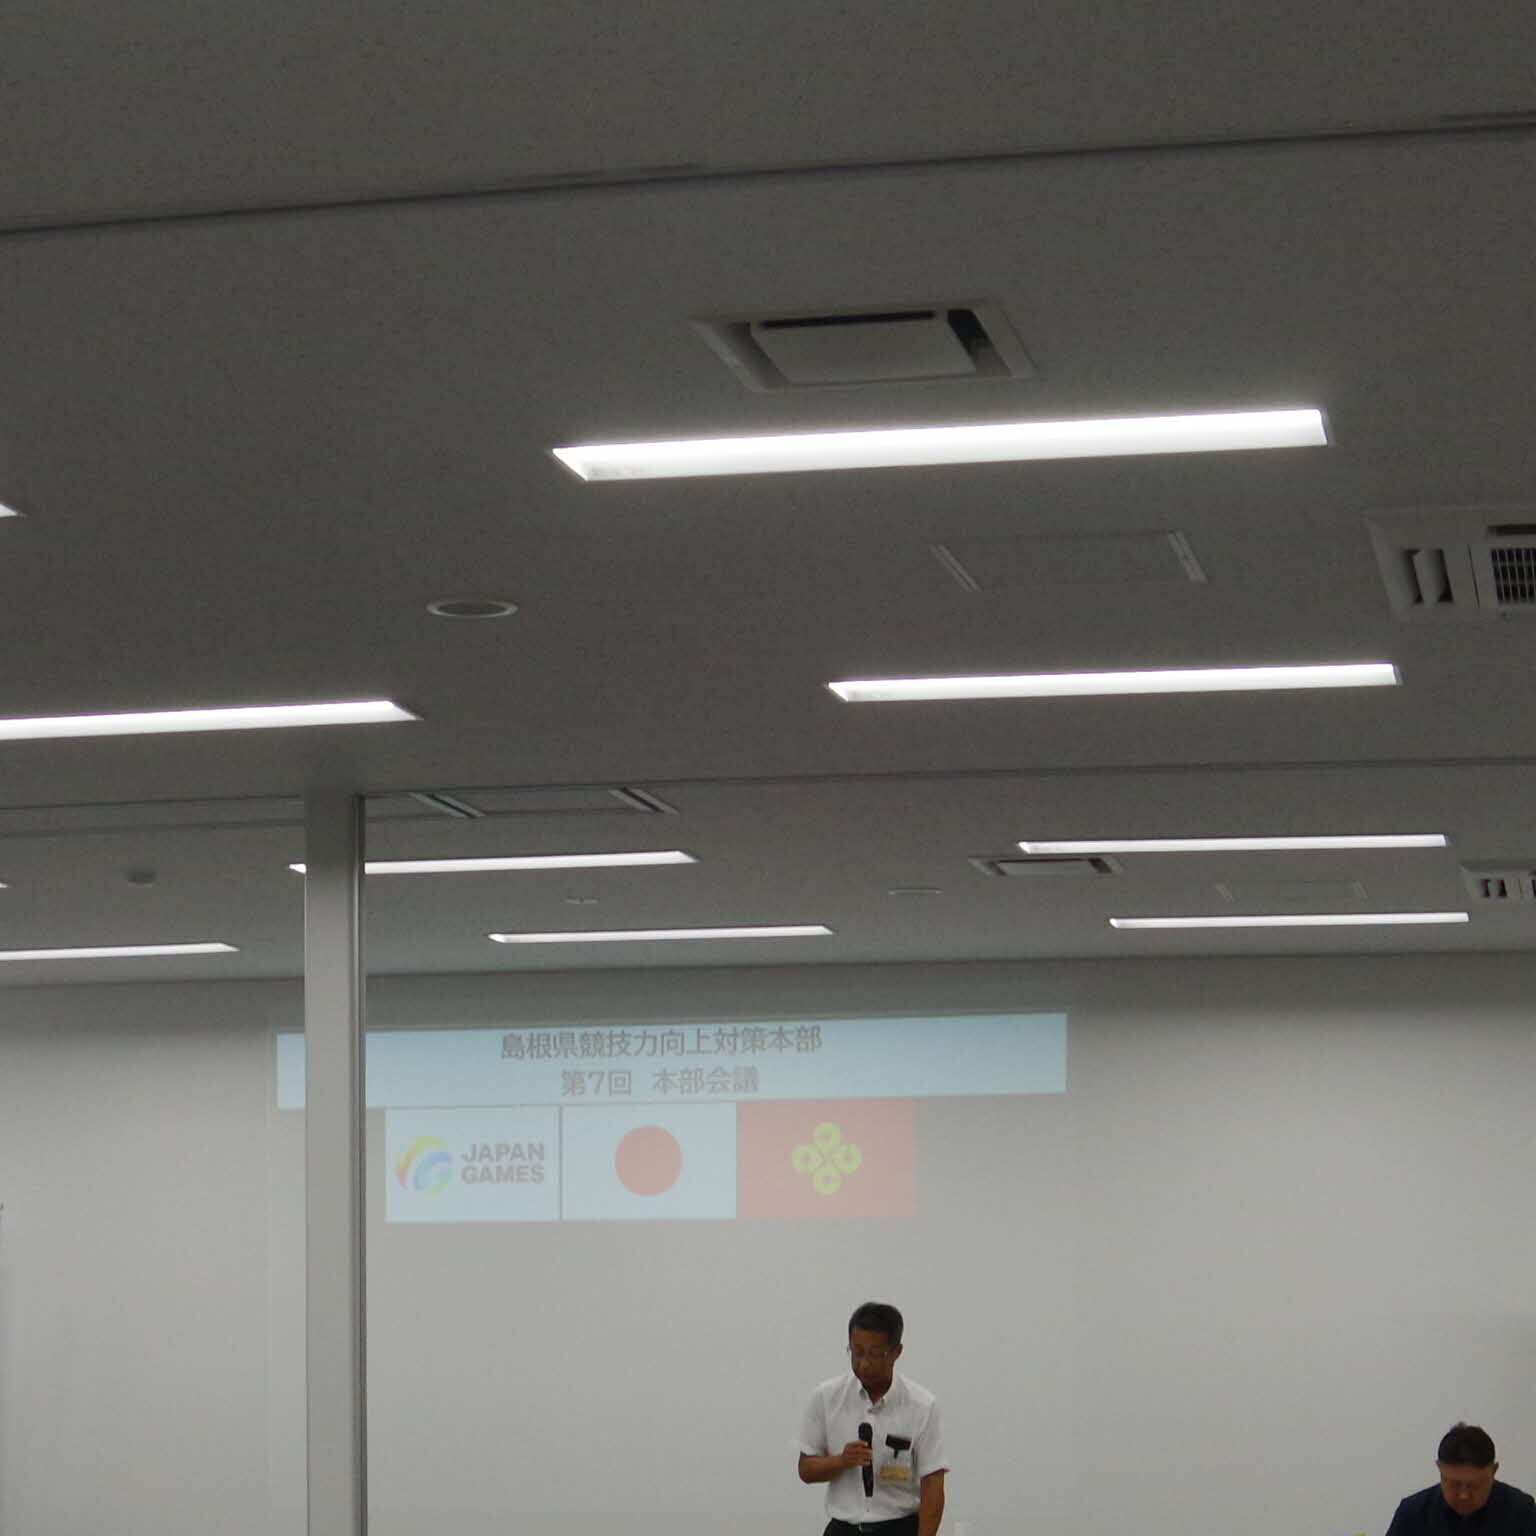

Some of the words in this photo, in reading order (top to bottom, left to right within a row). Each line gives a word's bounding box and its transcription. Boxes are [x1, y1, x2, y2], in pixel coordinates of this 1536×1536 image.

[501, 1025, 823, 1061] 島根県競技力向上対策本部
[560, 1068, 633, 1097] 第7回
[651, 1066, 759, 1095] 本部会議
[462, 1142, 545, 1163] JAPAN
[461, 1163, 545, 1186] GAMES
